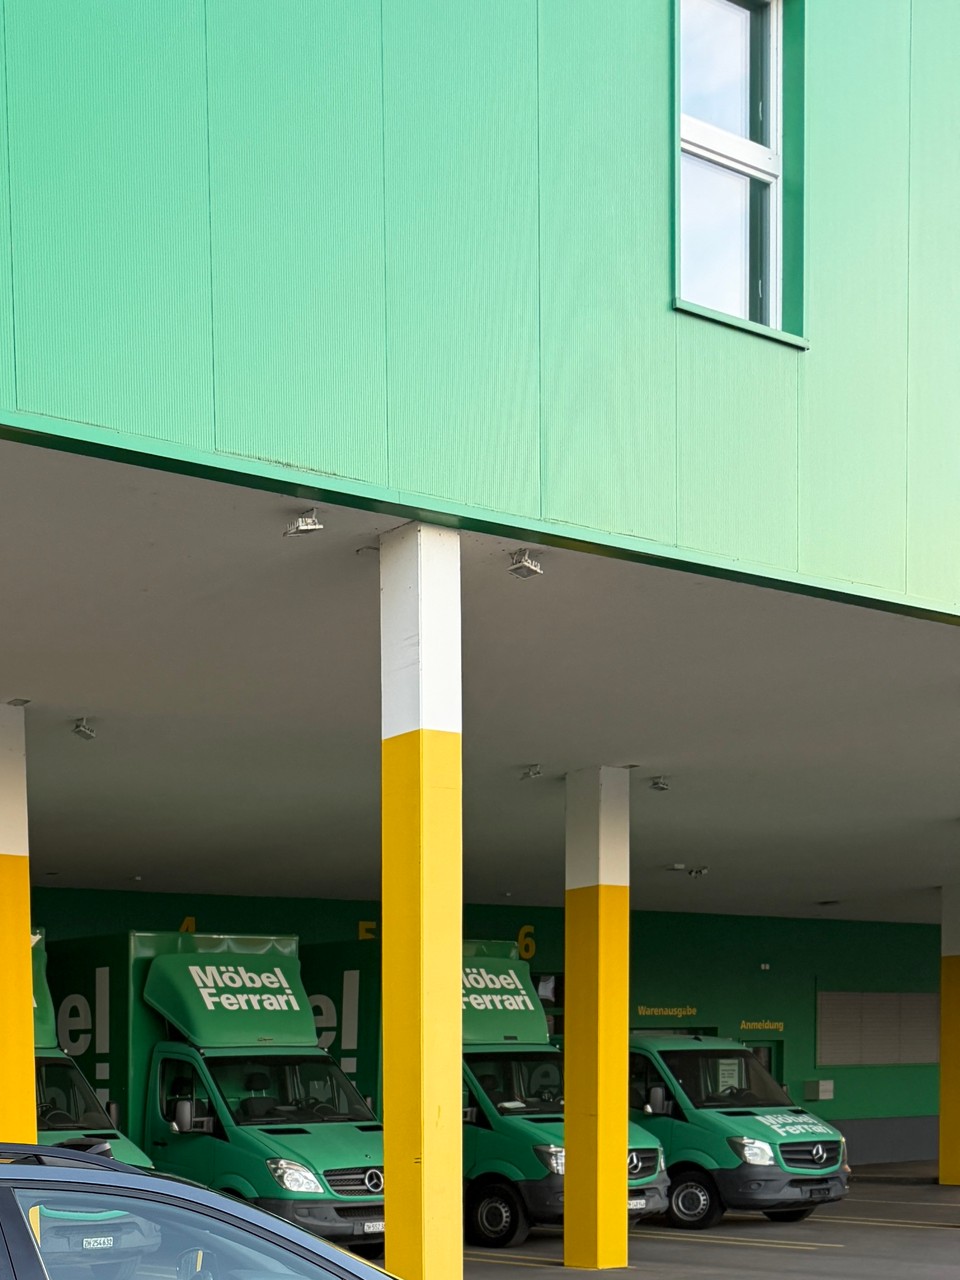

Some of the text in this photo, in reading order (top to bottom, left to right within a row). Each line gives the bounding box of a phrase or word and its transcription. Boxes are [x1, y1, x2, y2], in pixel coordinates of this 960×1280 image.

[518, 925, 536, 960] 6
[188, 966, 290, 988] Möbel
[199, 988, 300, 1011] Ferrari
[637, 1005, 697, 1018] Warenausgabe
[740, 1020, 784, 1032] Anmeldung
[755, 1114, 818, 1126] Möbel
[770, 1124, 834, 1137] Ferrari
